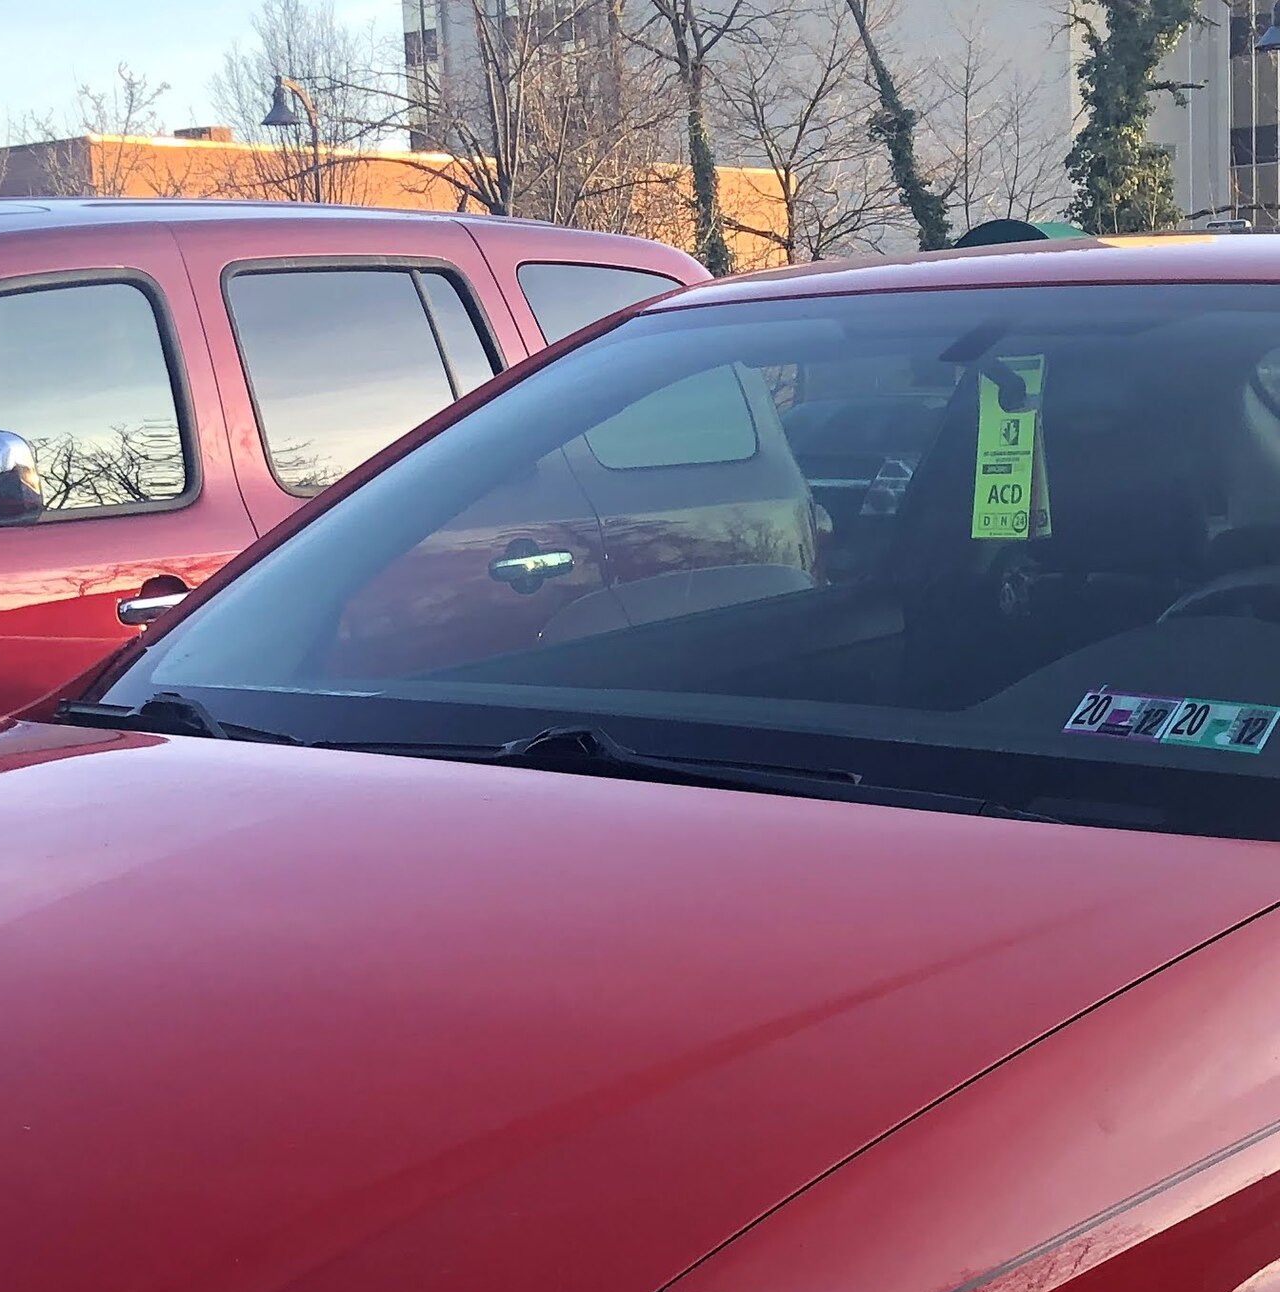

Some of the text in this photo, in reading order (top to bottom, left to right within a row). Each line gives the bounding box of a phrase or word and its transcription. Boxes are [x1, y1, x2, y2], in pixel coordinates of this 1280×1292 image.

[987, 484, 1023, 504] ACD
[983, 516, 991, 526] D
[1000, 516, 1008, 526] N
[1072, 695, 1168, 736] 20 12
[1170, 703, 1268, 746] 20 12
